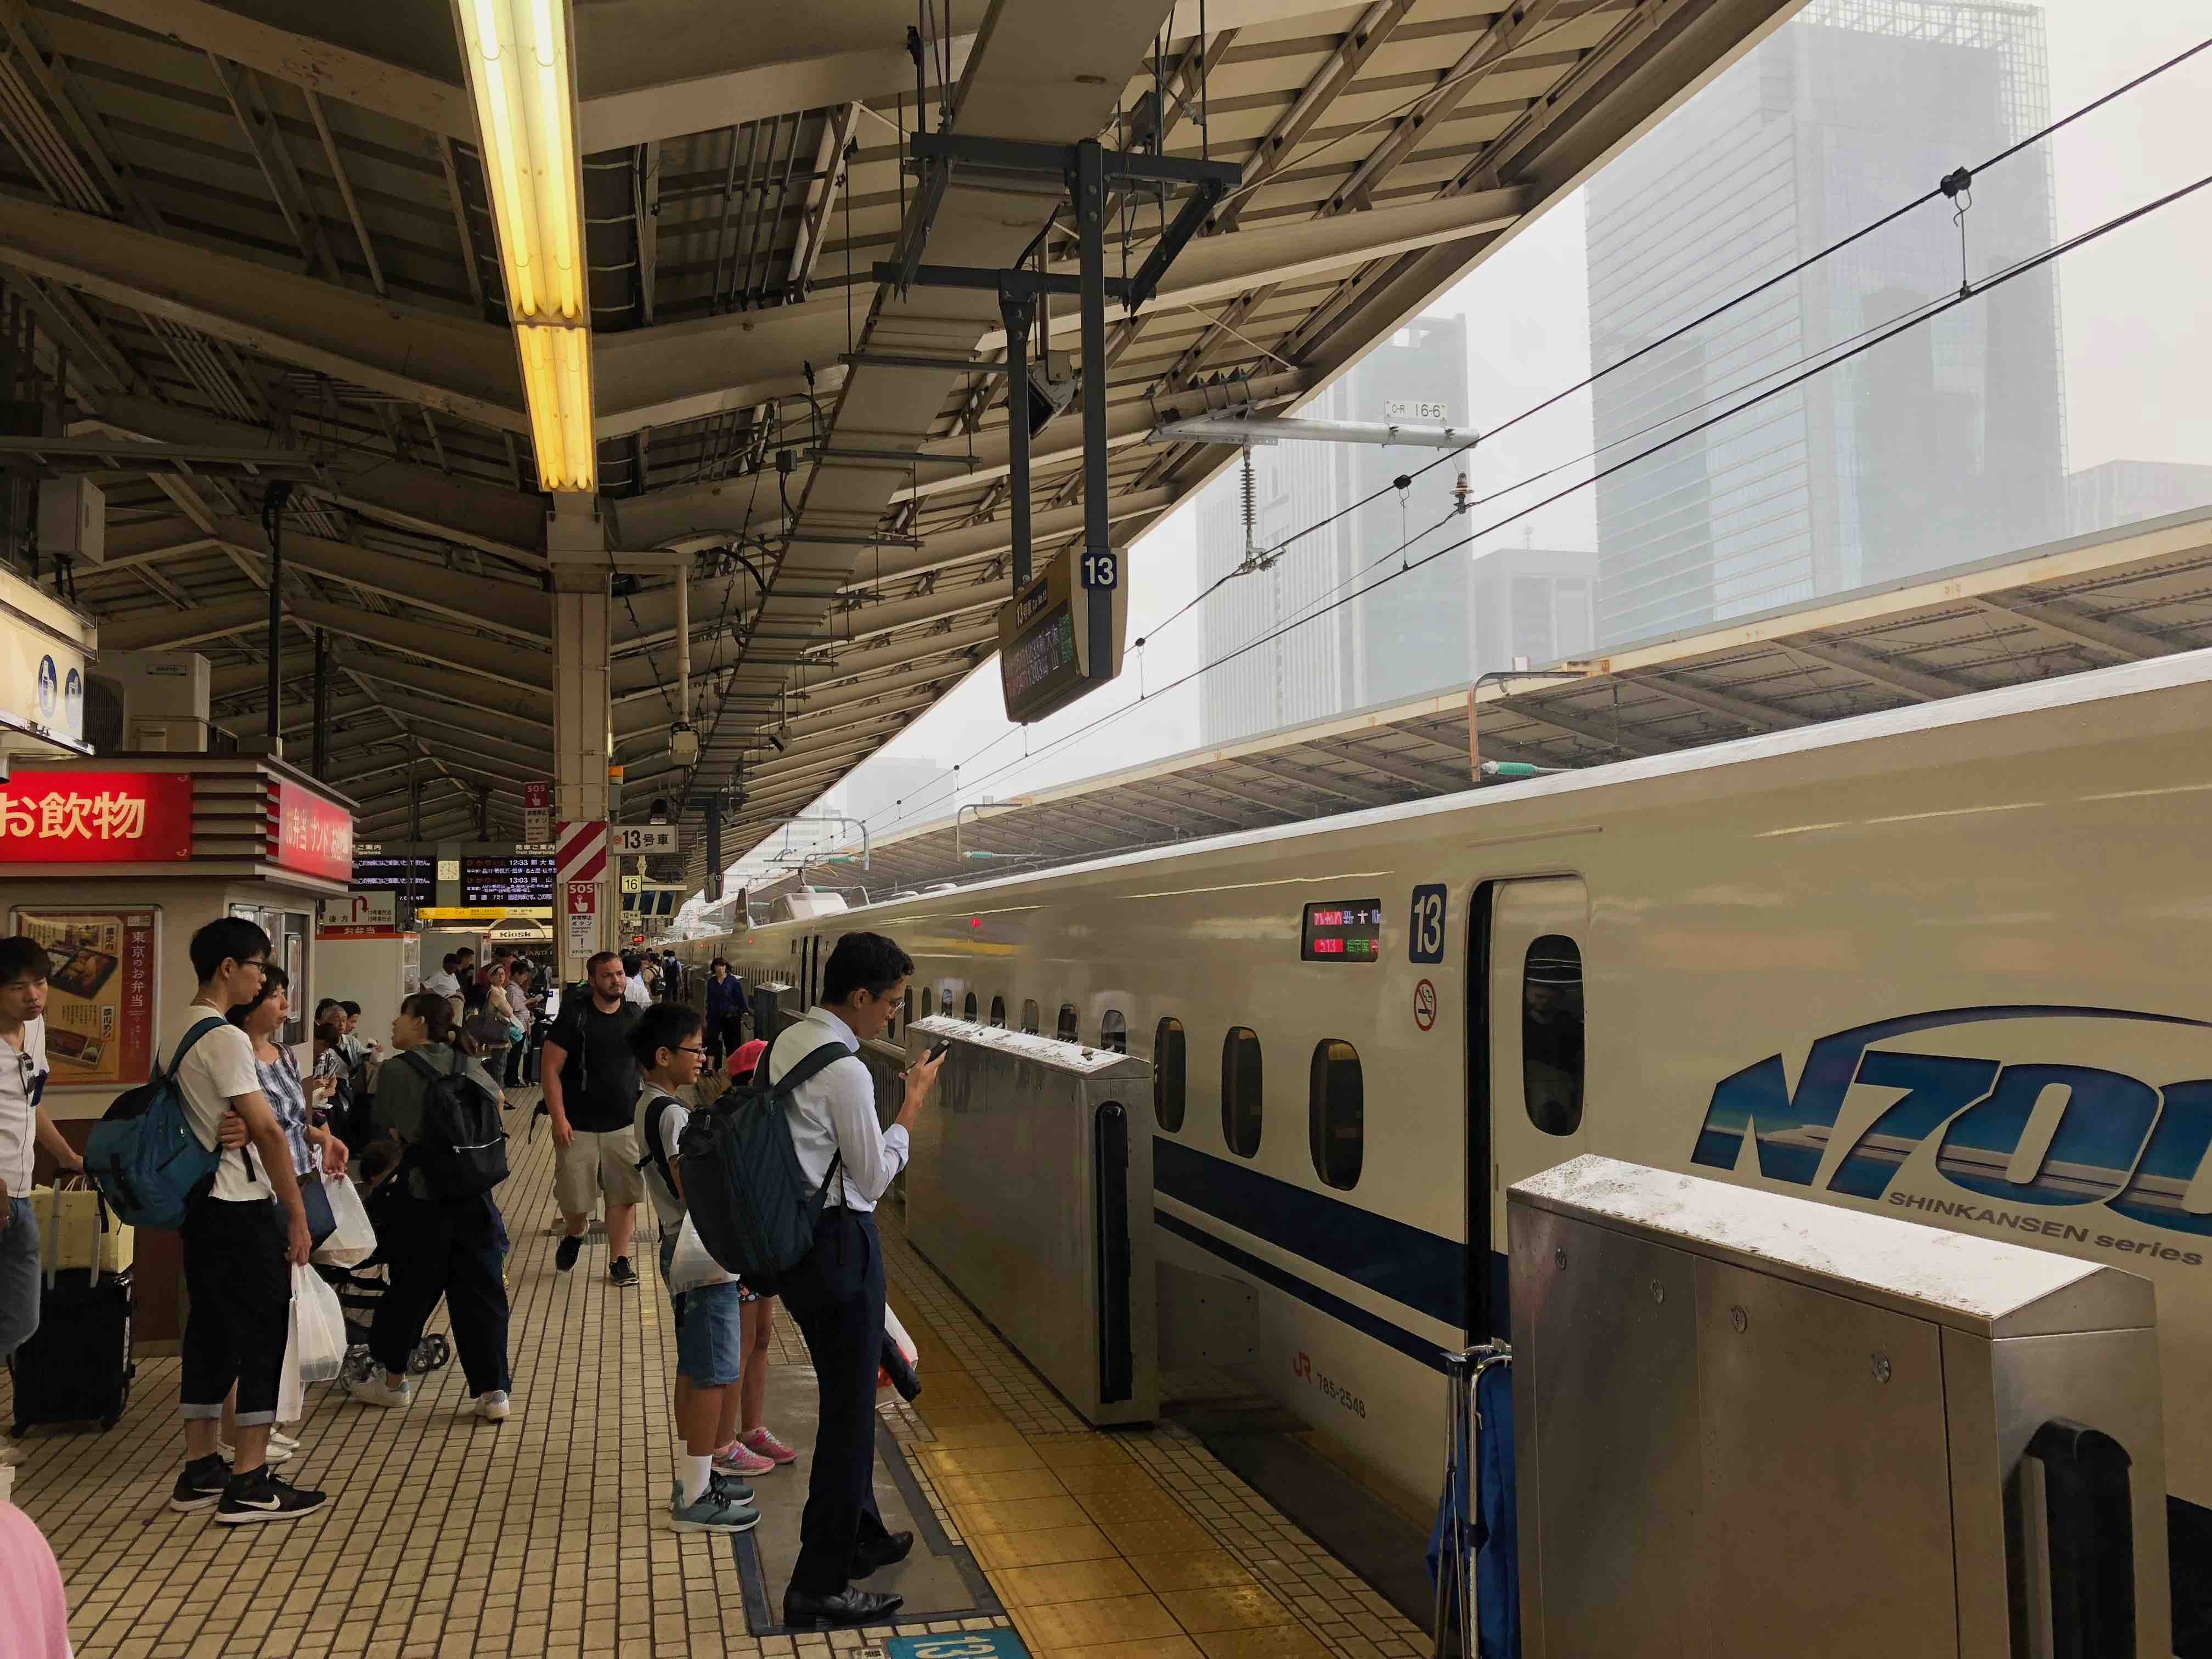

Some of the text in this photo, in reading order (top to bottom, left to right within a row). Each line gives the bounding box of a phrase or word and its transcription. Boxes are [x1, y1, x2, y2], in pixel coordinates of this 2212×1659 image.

[1085, 557, 1114, 584] 13
[0, 792, 145, 840] お飲物
[623, 830, 669, 849] 13号車
[569, 884, 594, 893] SOS
[625, 879, 637, 890] 16
[1414, 894, 1441, 953] 13
[131, 932, 145, 1007] 東京のお弁当
[1888, 1192, 2203, 1266] SHINKANSEN series
[1317, 1372, 1366, 1419] 785-2548
